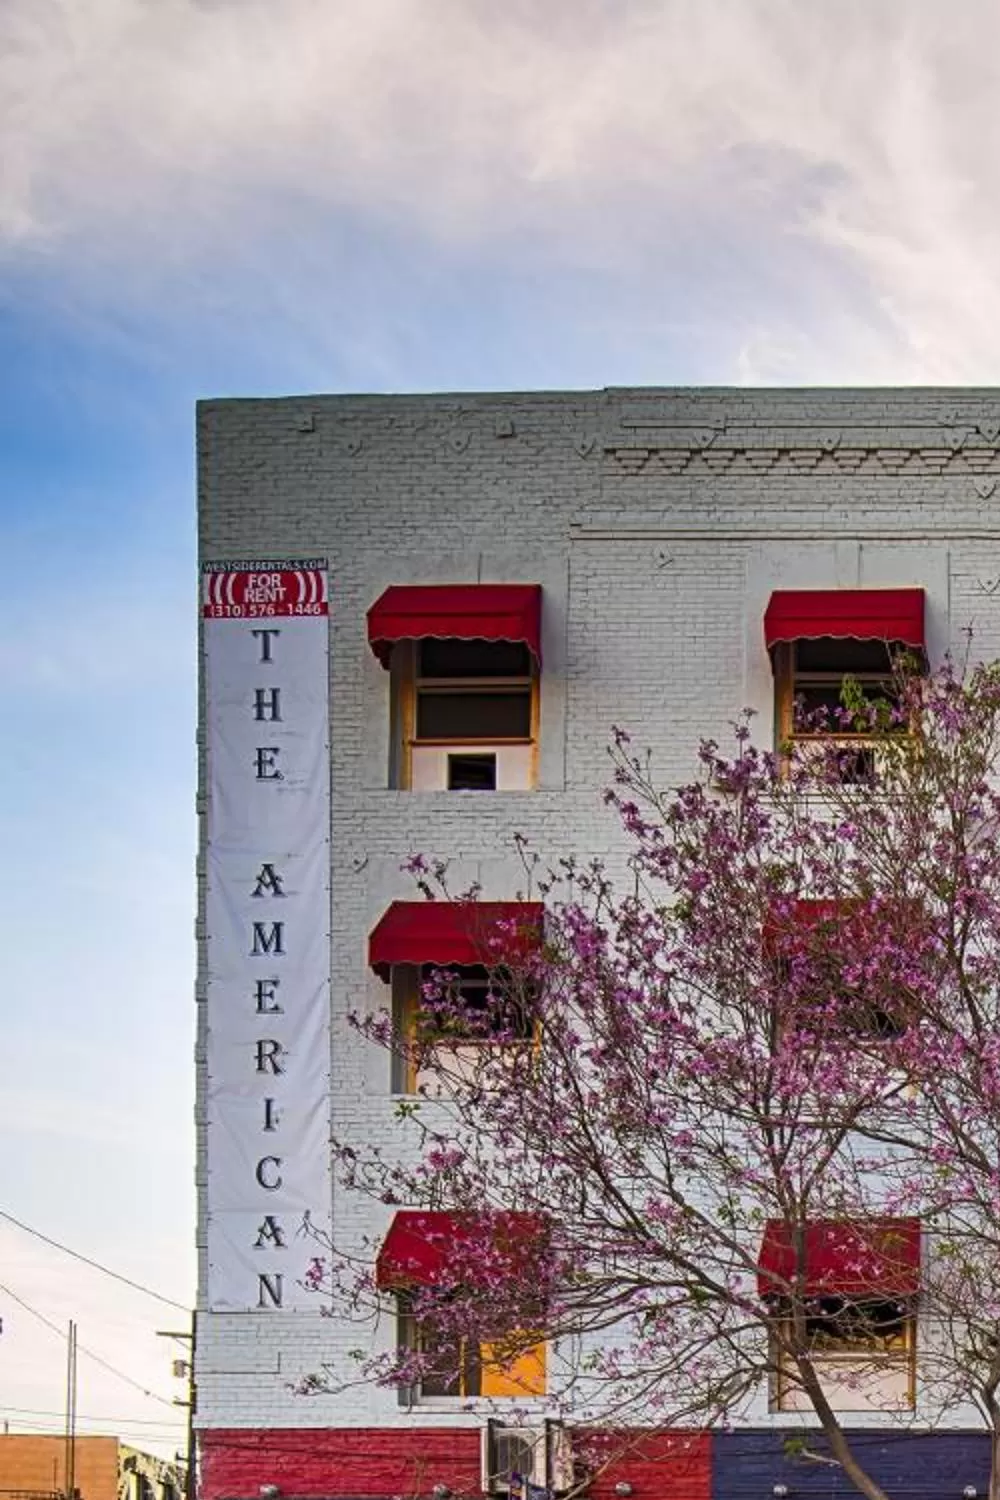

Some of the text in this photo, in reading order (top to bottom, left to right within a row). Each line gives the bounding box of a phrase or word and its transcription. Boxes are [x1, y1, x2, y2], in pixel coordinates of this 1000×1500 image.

[248, 573, 281, 588] FOR
[243, 587, 287, 603] RENT
[210, 604, 247, 617] (310)
[248, 629, 289, 1308] THE AMERICAN
